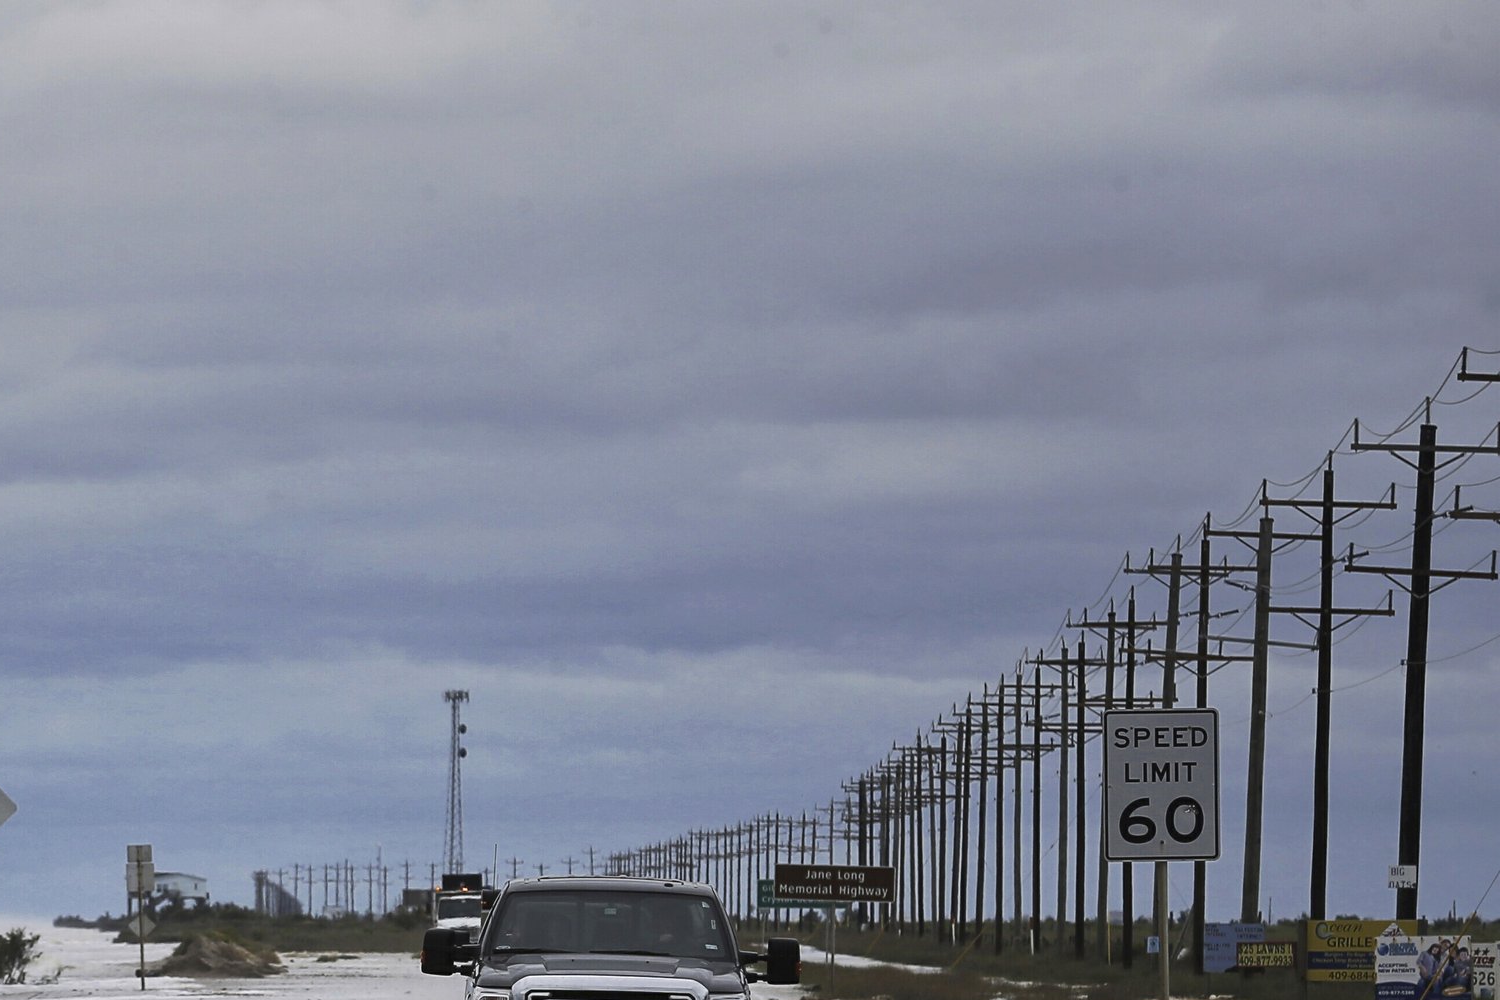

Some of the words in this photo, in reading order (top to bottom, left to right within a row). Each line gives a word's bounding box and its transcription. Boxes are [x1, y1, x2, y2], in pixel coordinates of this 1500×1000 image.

[1114, 727, 1208, 749] SPEED
[1124, 762, 1197, 783] LIMIT
[1119, 796, 1204, 844] 60
[805, 870, 832, 880] Jane
[837, 870, 865, 883] Long
[1391, 866, 1405, 876] BIG
[779, 883, 832, 895] Memorial
[839, 885, 888, 898] Highway
[1315, 922, 1363, 939] Ocean
[1256, 943, 1286, 954] LAWNS
[1327, 936, 1373, 948] GRILLE
[1238, 955, 1293, 966] 409-877-9933
